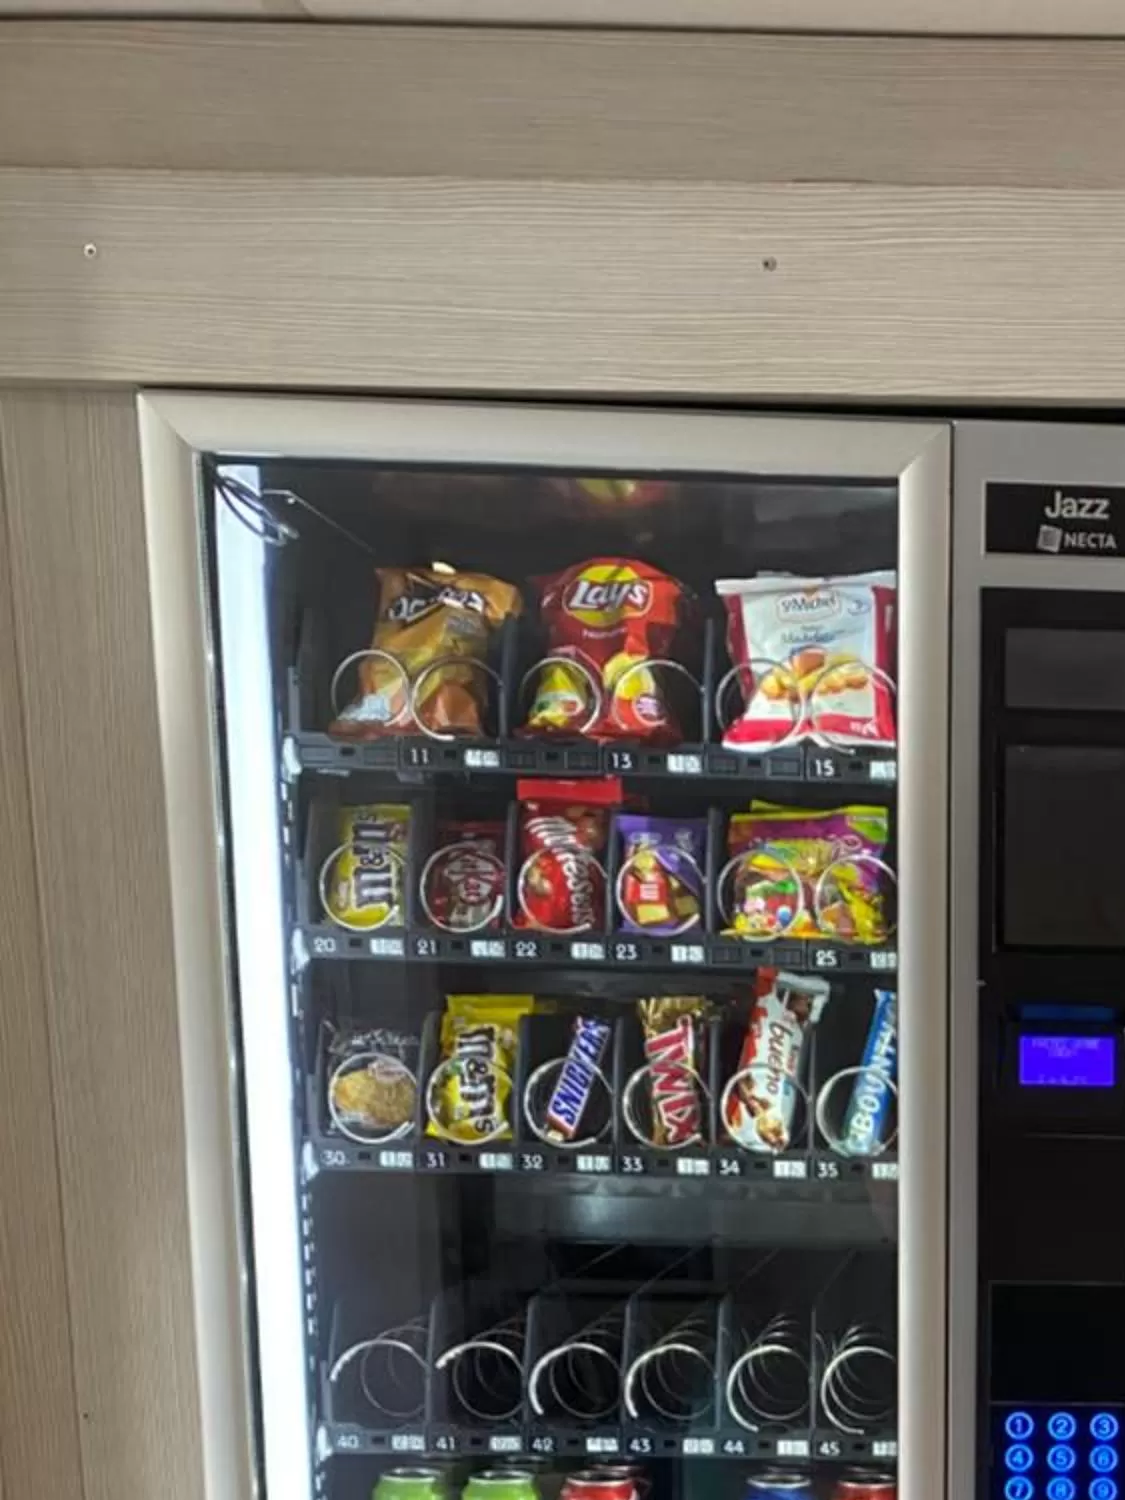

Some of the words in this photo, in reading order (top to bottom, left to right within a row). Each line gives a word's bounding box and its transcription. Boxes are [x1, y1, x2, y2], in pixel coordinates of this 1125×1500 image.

[1044, 490, 1109, 519] Jazz
[1063, 532, 1117, 549] NECTA
[569, 579, 650, 613] Lay's
[411, 749, 429, 764] 11
[612, 753, 632, 769] 13
[815, 759, 835, 776] 15
[314, 938, 335, 952] 20
[417, 940, 436, 955] 21
[516, 942, 537, 957] 22
[616, 944, 637, 959] 23
[816, 951, 837, 967] 25
[767, 1019, 793, 1095] bueno
[322, 1152, 345, 1166] 30
[426, 1153, 445, 1168] 31
[522, 1155, 543, 1170] 32
[622, 1156, 643, 1171] 33
[719, 1160, 740, 1175] 34
[817, 1162, 838, 1178] 35
[436, 1437, 455, 1450] 41
[532, 1437, 553, 1451] 42
[629, 1439, 651, 1452] 43
[724, 1440, 744, 1454] 44
[820, 1441, 840, 1455] 45
